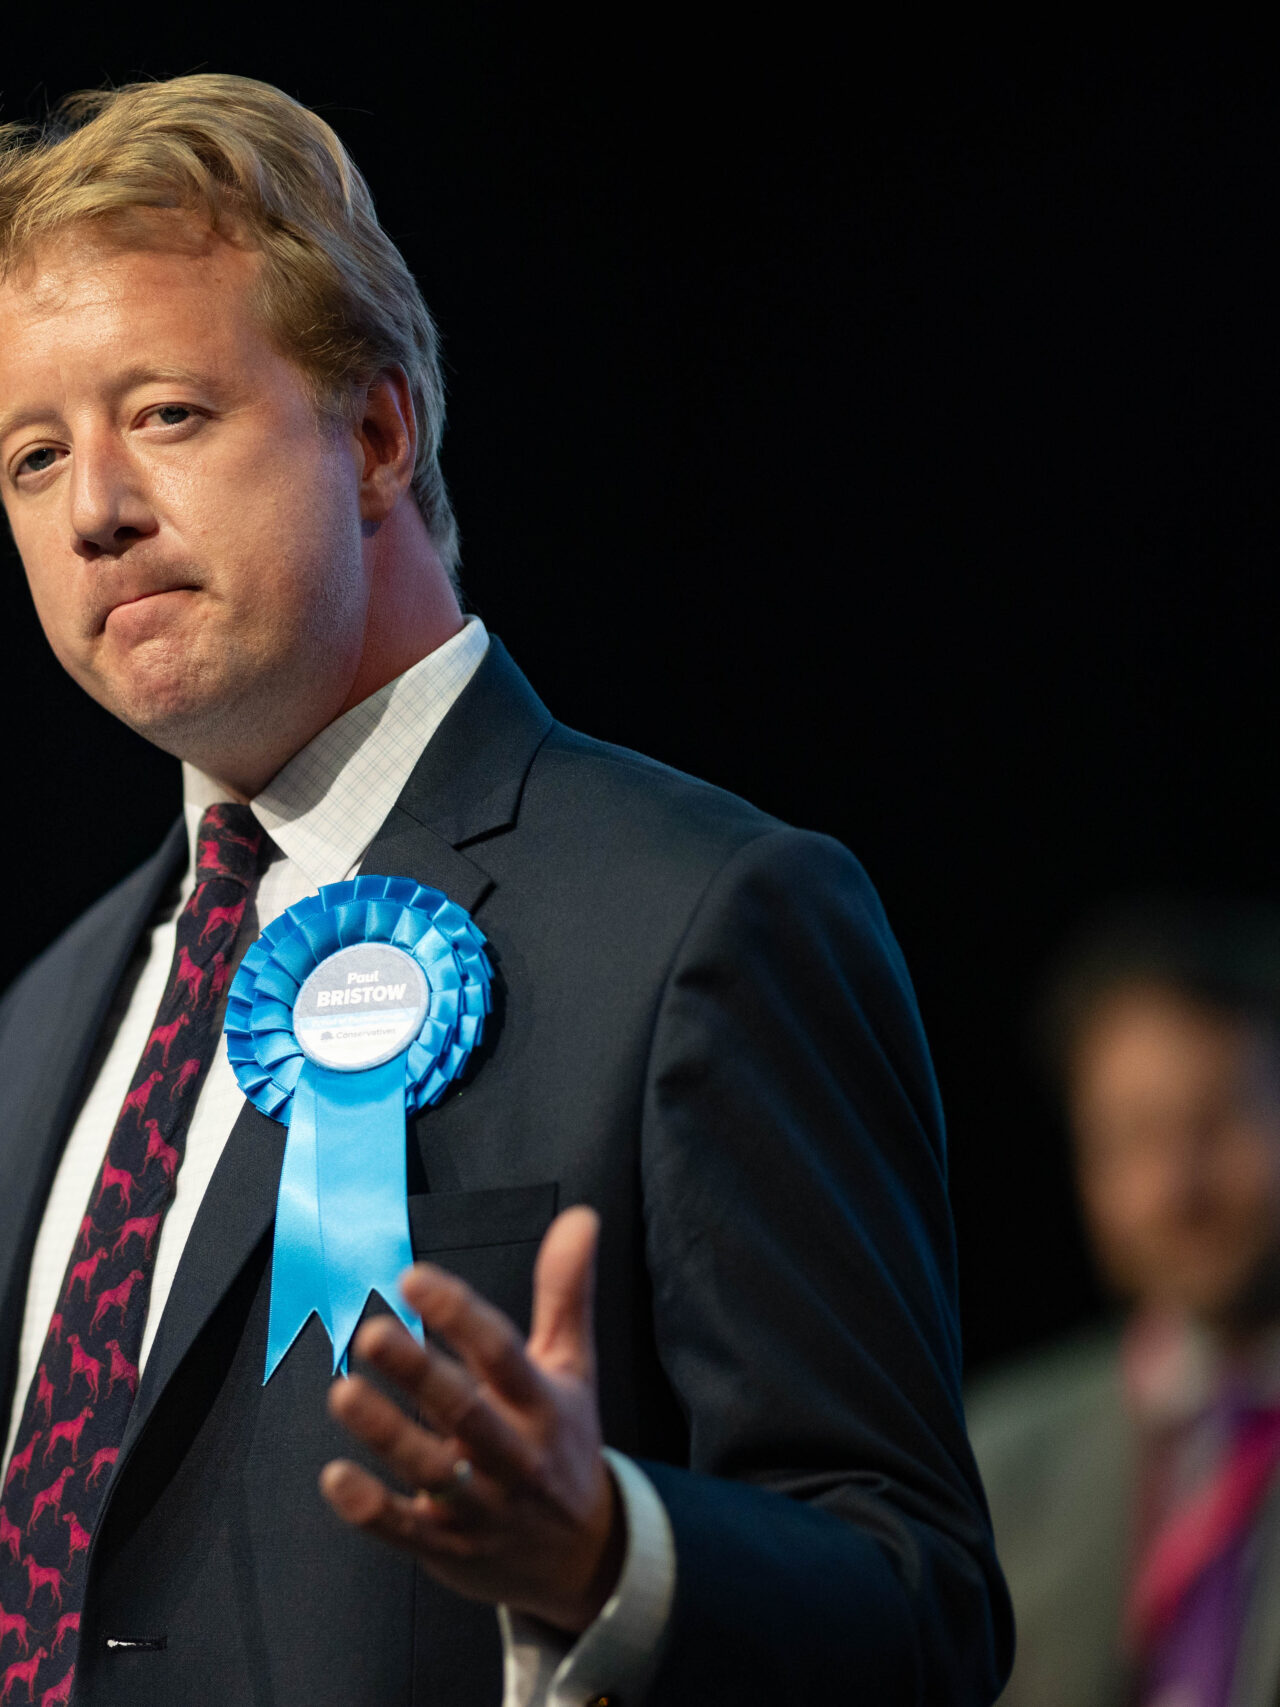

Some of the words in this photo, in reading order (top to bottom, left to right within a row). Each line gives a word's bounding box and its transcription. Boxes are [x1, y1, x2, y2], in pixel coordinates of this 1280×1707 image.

[347, 970, 379, 984] Paul
[317, 984, 407, 1007] BRISTOW
[336, 1028, 396, 1039] Conservatives
